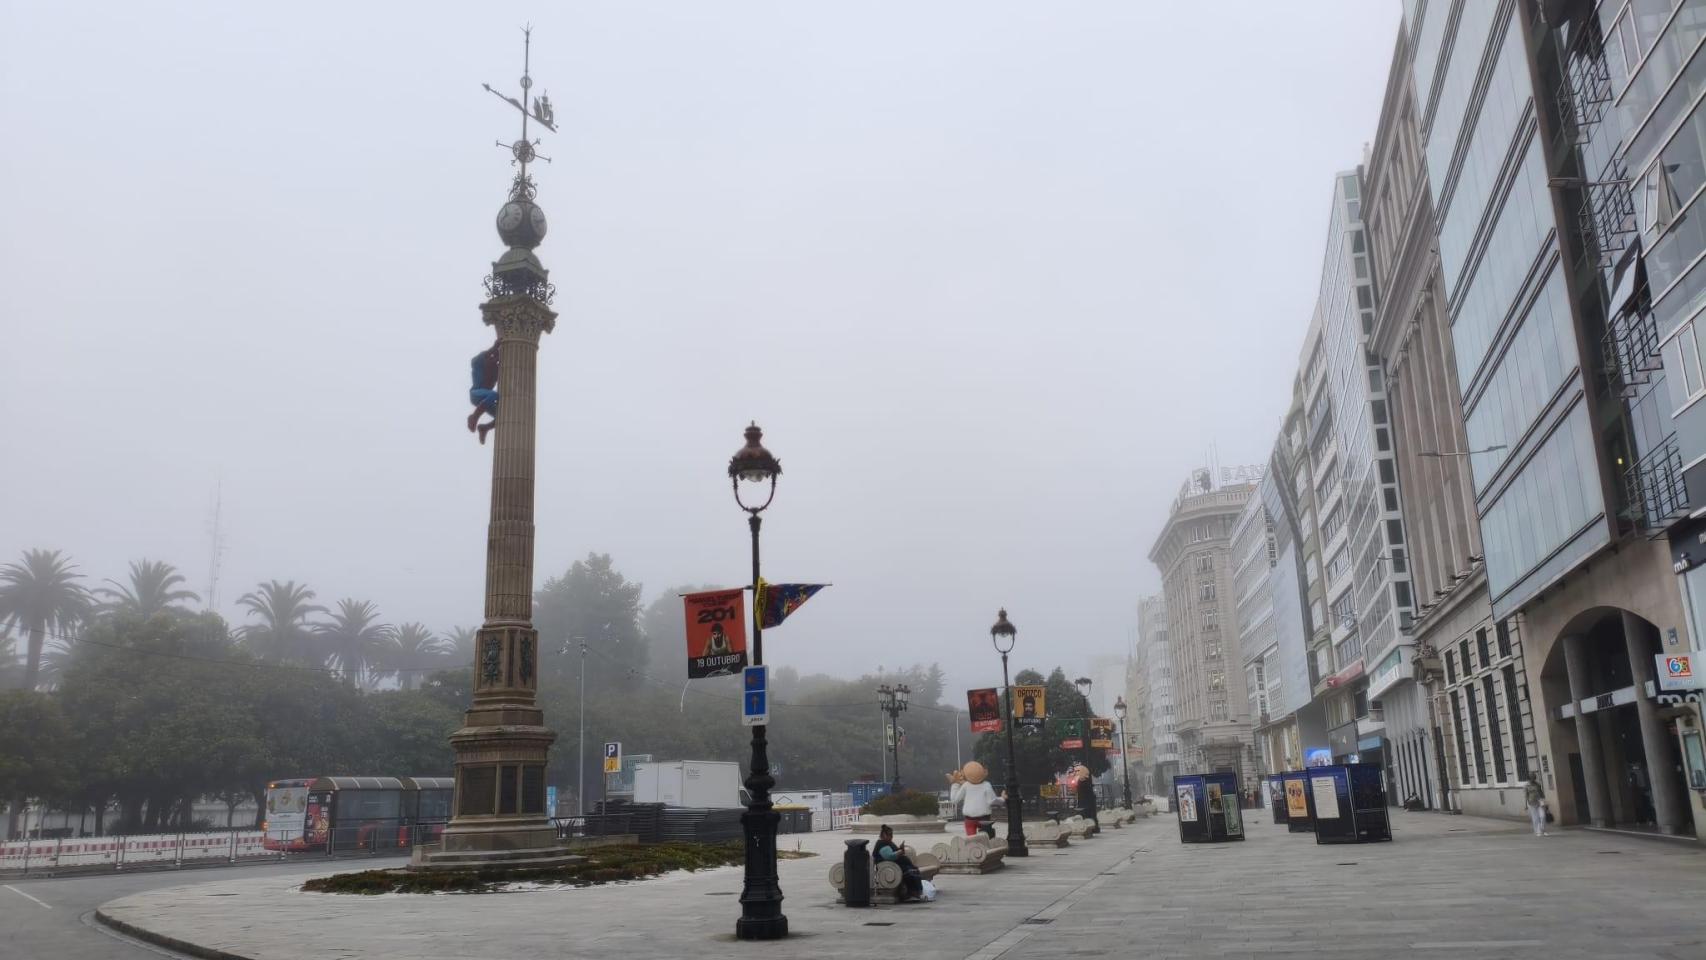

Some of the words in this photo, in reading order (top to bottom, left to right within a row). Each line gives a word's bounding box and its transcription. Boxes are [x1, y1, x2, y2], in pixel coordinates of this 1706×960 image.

[697, 606, 736, 624] 201
[697, 659, 705, 667] 19
[706, 654, 741, 667] OUTUBRO
[1017, 689, 1042, 697] OROZCO
[608, 745, 615, 756] P
